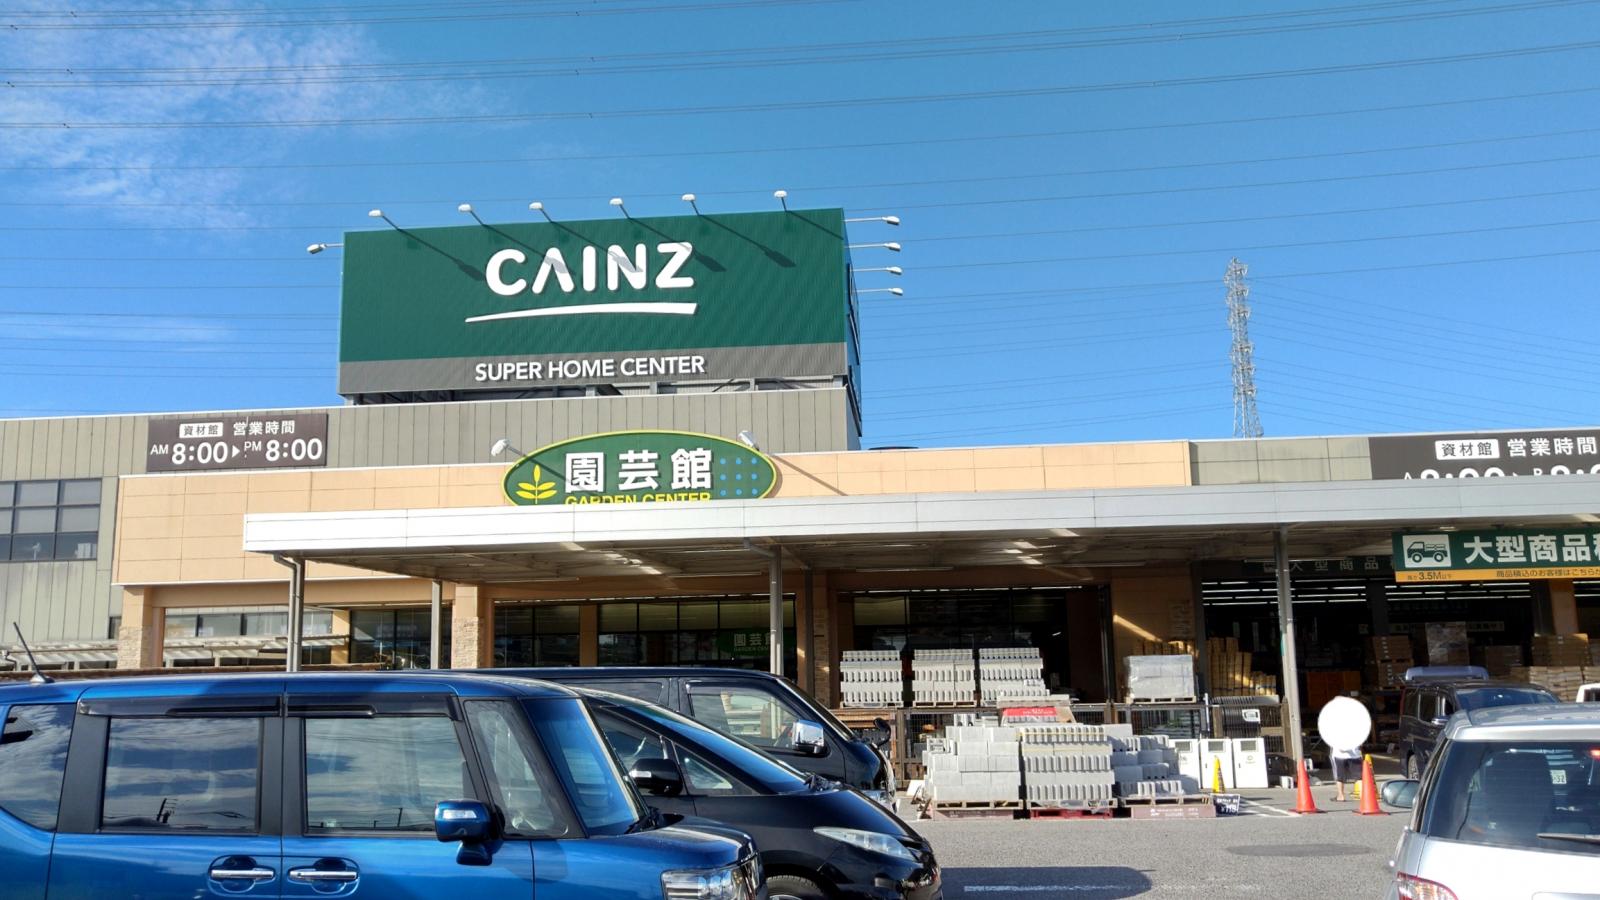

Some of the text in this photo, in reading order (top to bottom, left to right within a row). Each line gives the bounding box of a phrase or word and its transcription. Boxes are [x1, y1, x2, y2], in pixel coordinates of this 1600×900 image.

[486, 242, 695, 296] CAINZ
[475, 356, 706, 382] SUPER HOME CENTER
[183, 420, 296, 436] 資材館 営業時間
[150, 438, 323, 465] AM 8:00 PM 8:00
[1441, 436, 1597, 457] 資材館 営業時間
[565, 447, 712, 493] 園芸館
[1463, 534, 1600, 564] 大型商品
